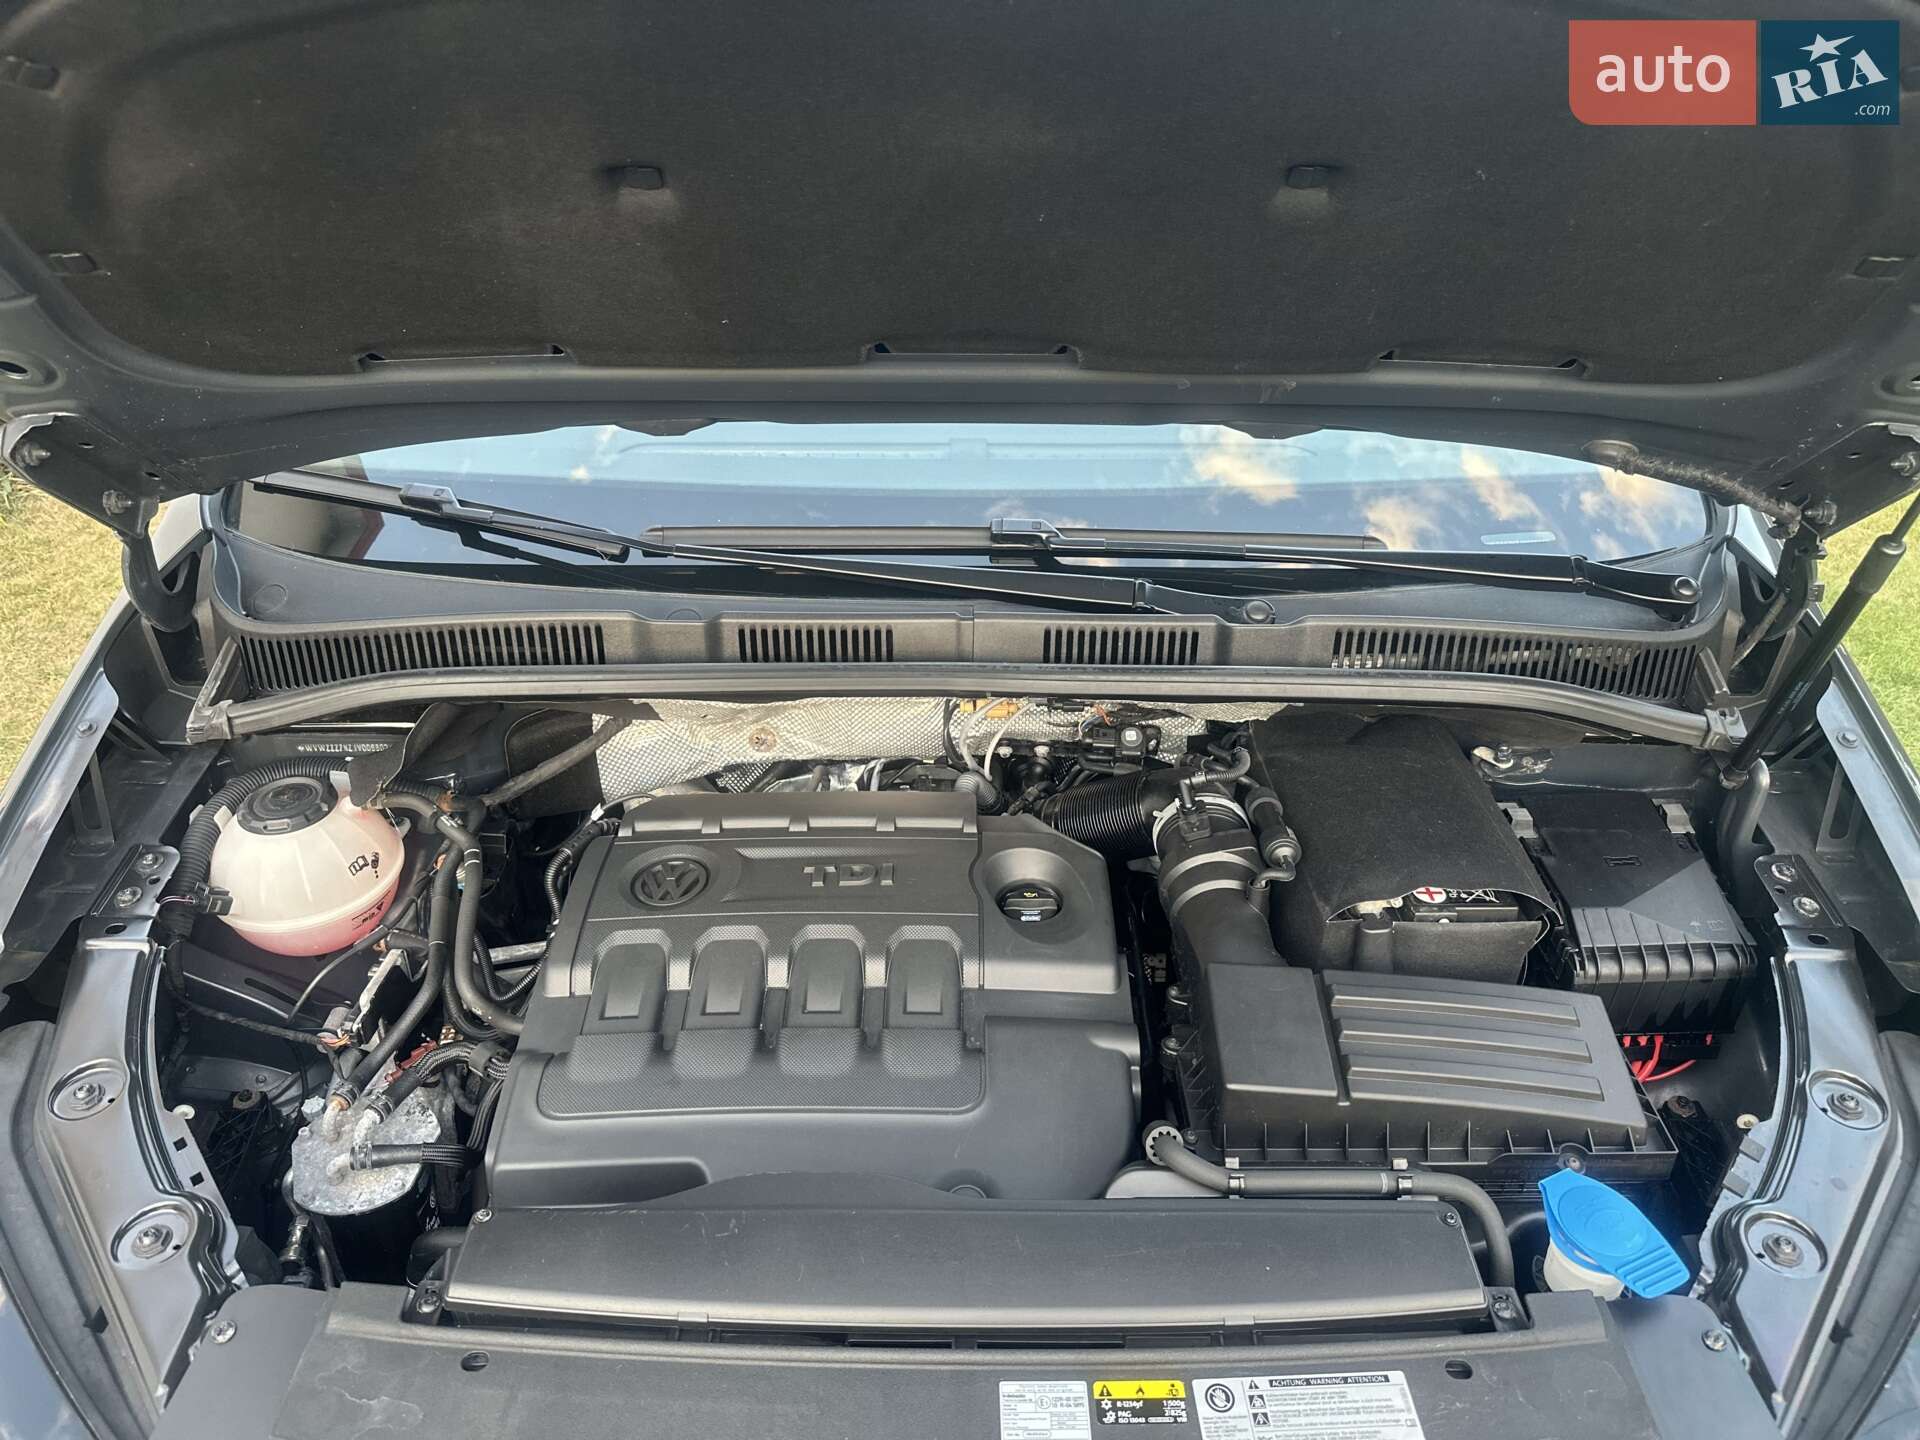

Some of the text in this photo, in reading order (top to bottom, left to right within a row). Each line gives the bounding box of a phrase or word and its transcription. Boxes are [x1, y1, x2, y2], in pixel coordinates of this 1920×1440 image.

[802, 862, 896, 888] TDI
[1271, 1375, 1385, 1387] ACHTUNG WARNING ATTENTION
